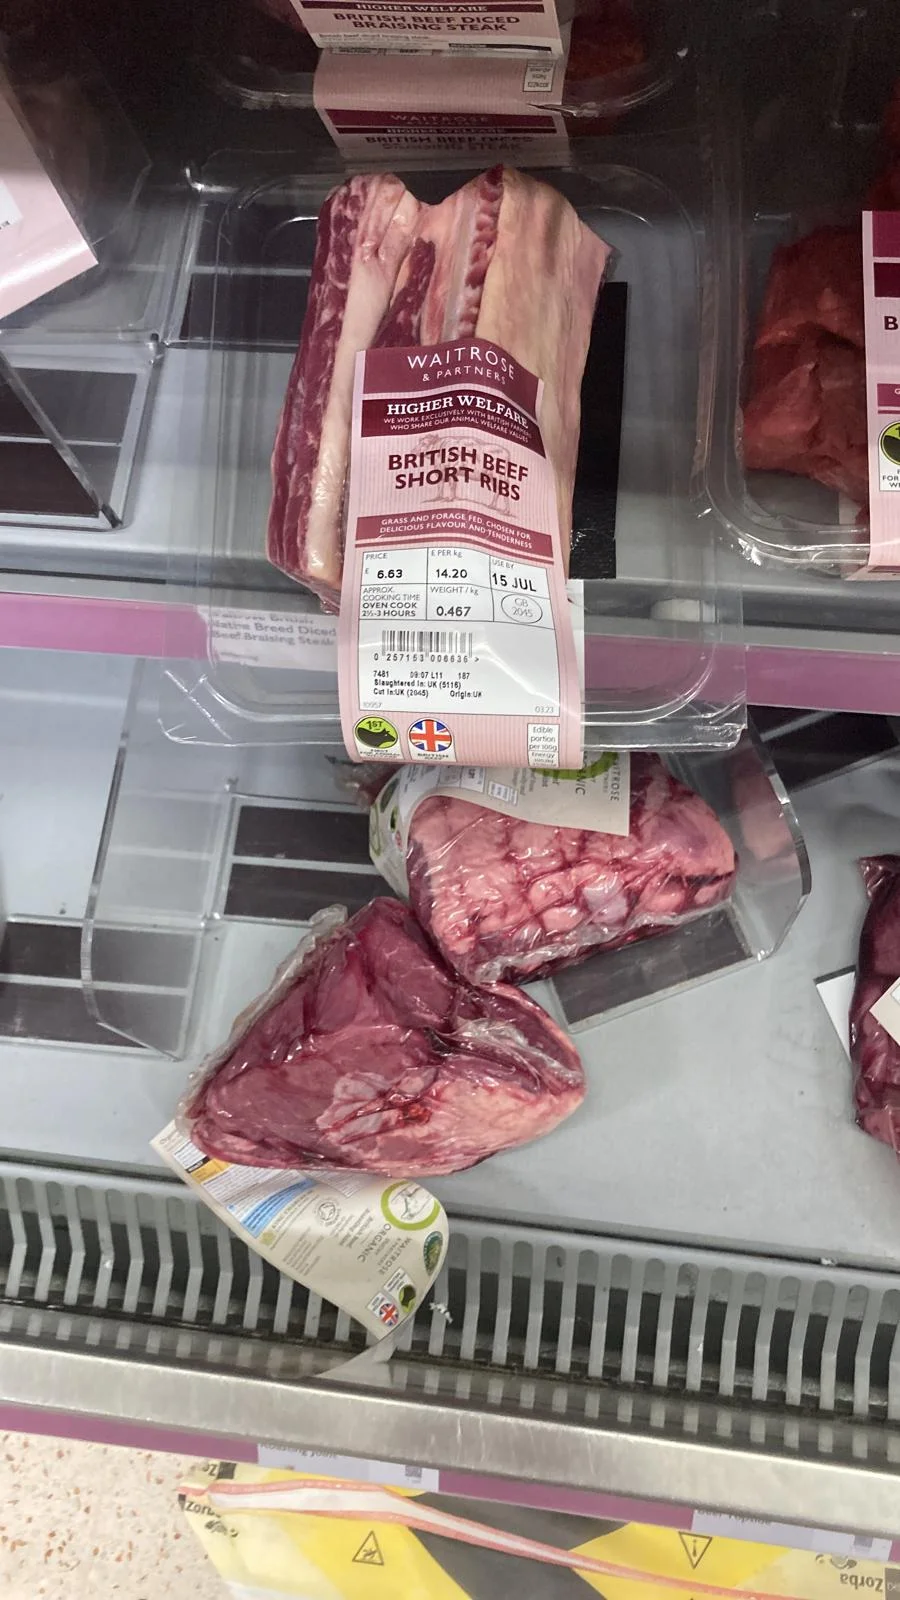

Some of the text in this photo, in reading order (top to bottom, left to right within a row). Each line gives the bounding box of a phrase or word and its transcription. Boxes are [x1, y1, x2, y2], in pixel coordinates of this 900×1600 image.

[333, 13, 520, 24] BRITISH BEEF DICED
[352, 22, 442, 30] BRAISING
[407, 346, 515, 380] WAITROSE
[422, 366, 506, 384] & PARTNERS
[387, 396, 528, 428] HIGHER WELFARE
[422, 409, 464, 421] EXCLUSIVELY
[467, 410, 486, 418] WITH
[411, 421, 432, 430] SHARE
[434, 418, 450, 426] OUR
[451, 416, 479, 424] ANIMAL
[481, 420, 508, 434] WELFARE
[388, 446, 529, 482] BRITISH BEEF
[395, 466, 520, 501] SHORT RIBS
[381, 517, 408, 526] GRASS
[410, 514, 430, 522] AND
[432, 512, 466, 520] FORAGE
[486, 520, 514, 536] CHOSEN
[516, 530, 531, 540] FOR
[380, 521, 532, 549] DELICIOUS FLAVOUR AND TENDERNESS
[365, 552, 388, 560] PRICE
[454, 549, 462, 558] kg
[492, 560, 504, 568] USE
[377, 569, 403, 579] 6.63
[436, 568, 468, 579] 14.20
[492, 572, 536, 592] 15 JUL
[430, 586, 463, 594] WEIGHT
[470, 588, 479, 596] kg
[436, 606, 472, 617] 0.467
[298, 626, 336, 636] Diced
[373, 670, 390, 678] 7481
[374, 679, 416, 688] Slaughtered
[373, 688, 385, 696] Cut
[366, 720, 383, 730] 1ST
[532, 726, 554, 734] Edible
[356, 1223, 392, 1263] ORGANIC
[840, 1572, 884, 1592] Zorba
